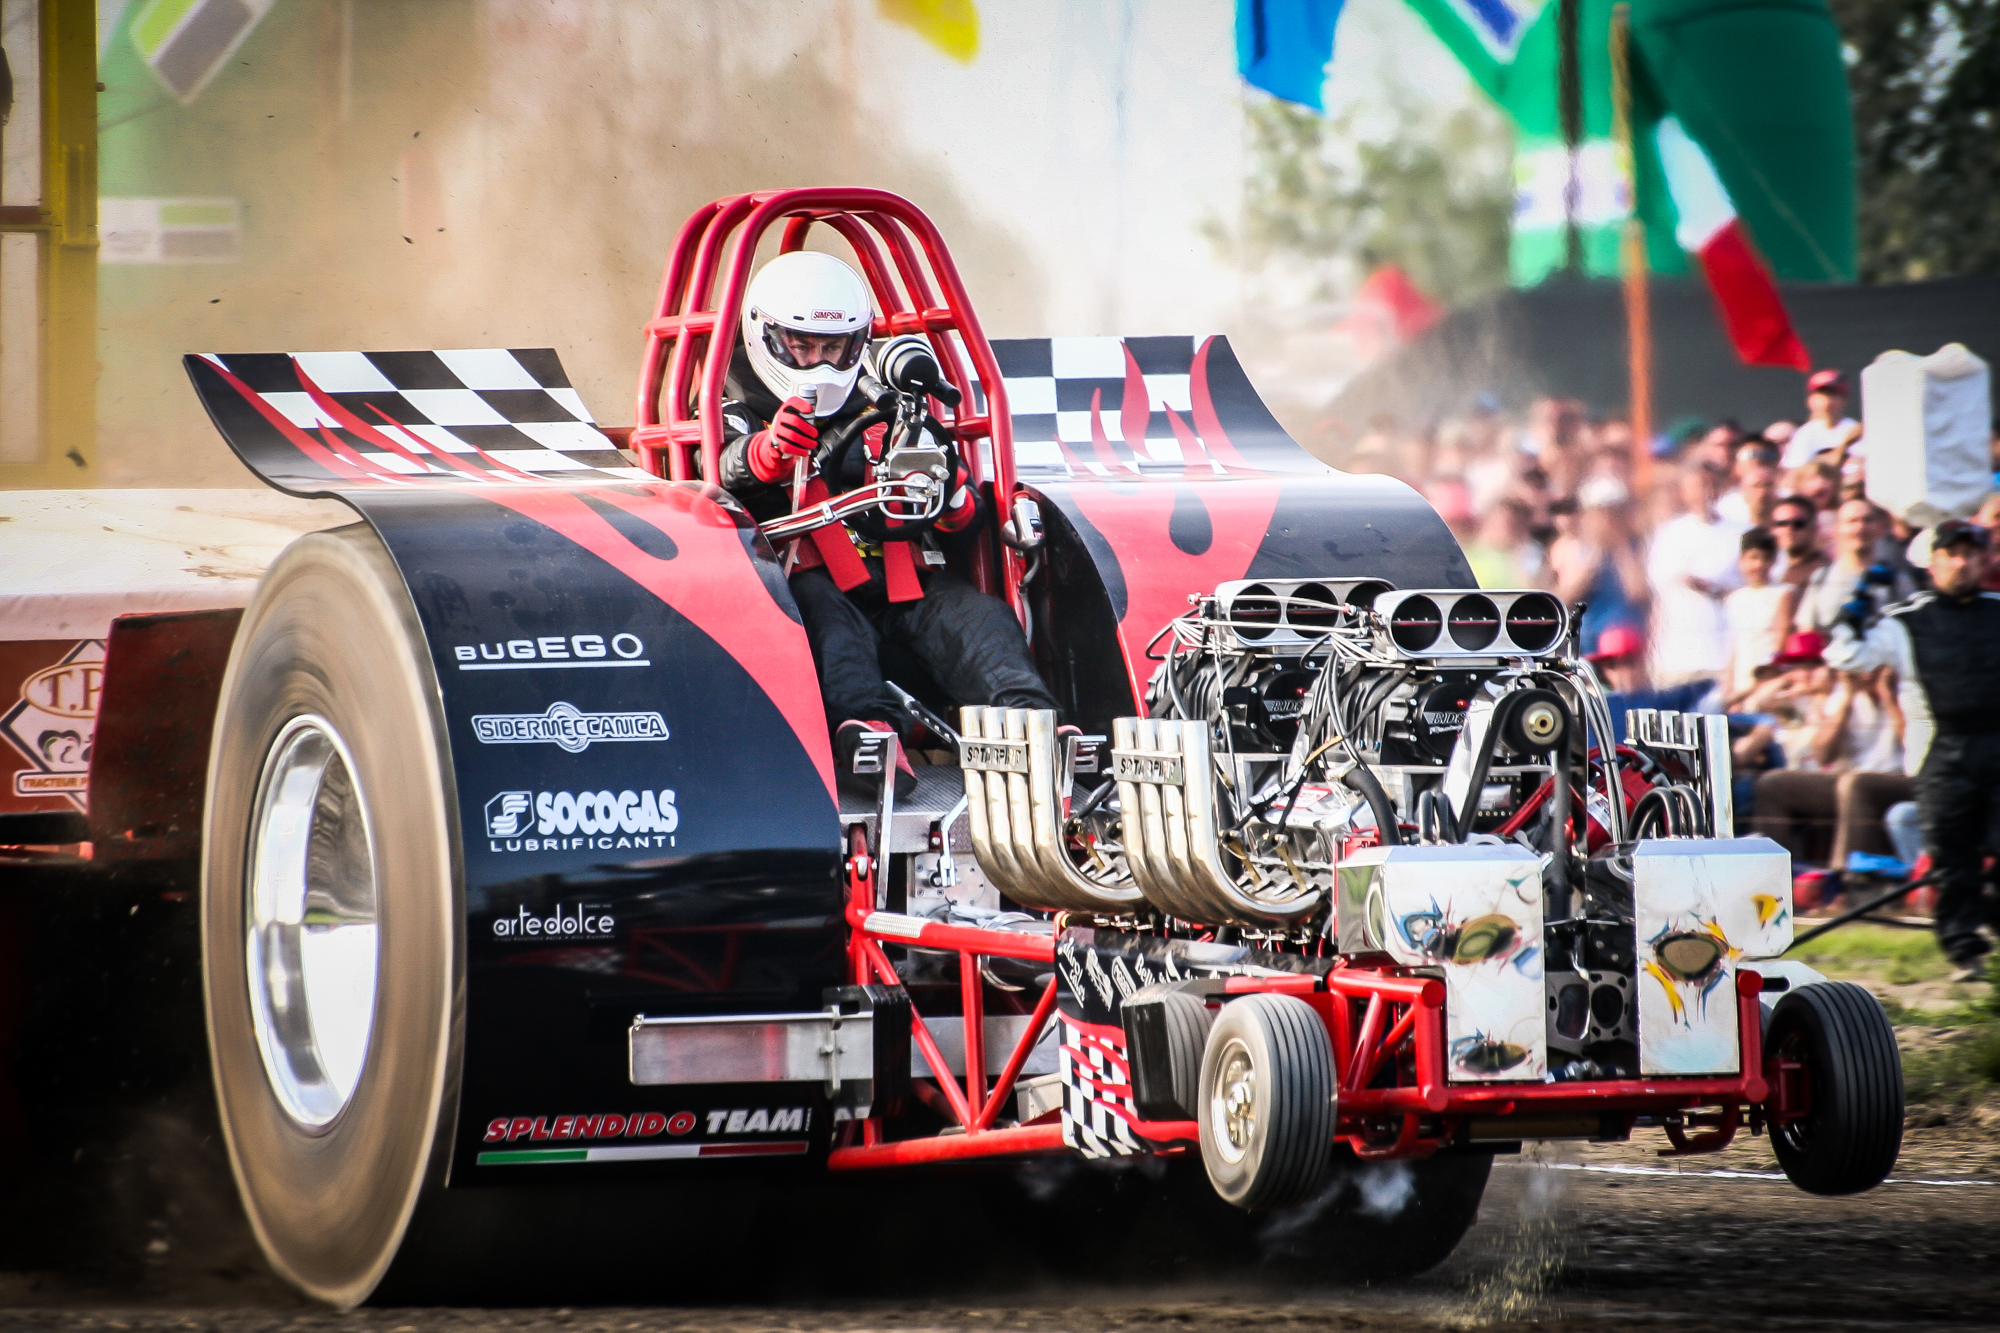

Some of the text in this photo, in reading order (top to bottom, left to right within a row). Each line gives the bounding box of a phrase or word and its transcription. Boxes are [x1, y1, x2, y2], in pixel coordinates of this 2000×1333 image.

[813, 310, 843, 320] SIMPSON
[454, 632, 644, 661] BUGEGO
[479, 715, 665, 739] SIDERMECCANICA
[22, 777, 78, 789] TRACTEUR
[536, 789, 679, 836] SOCOGAS
[490, 835, 676, 853] LUBRIFICANTI
[483, 1110, 697, 1143] SPLENDIDO
[706, 1107, 804, 1135] TEAM
